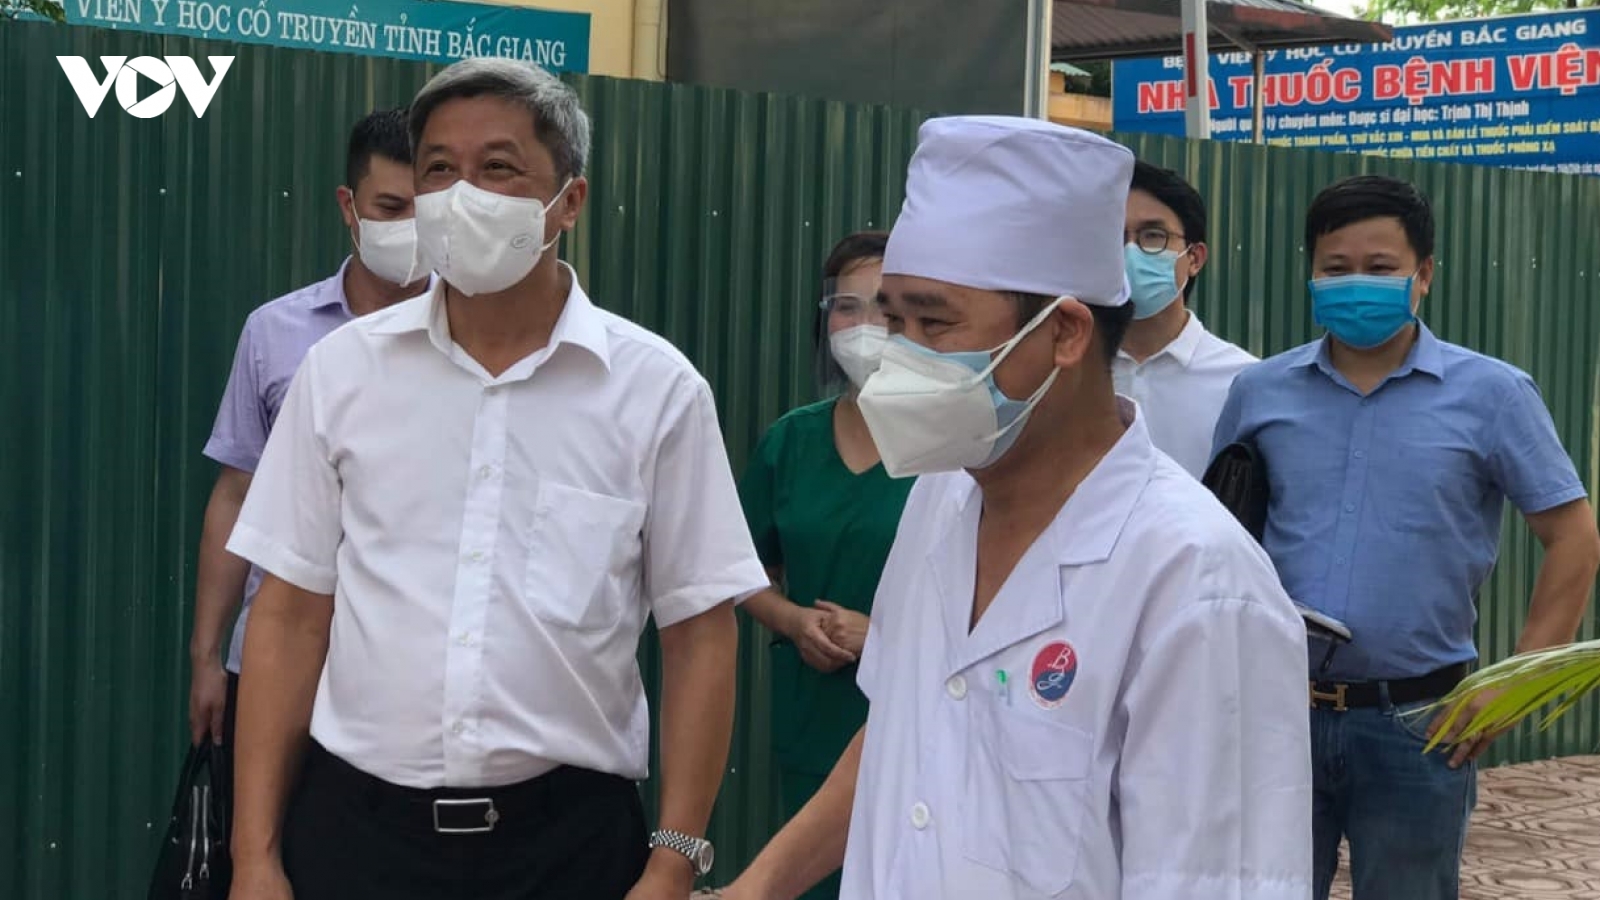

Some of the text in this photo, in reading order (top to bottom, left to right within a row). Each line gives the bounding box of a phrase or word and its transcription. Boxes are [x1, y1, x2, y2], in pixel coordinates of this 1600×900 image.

[178, 1, 231, 38] HỌC
[277, 5, 377, 49] TRUYỀN
[383, 13, 442, 56] TỈNH
[447, 17, 491, 58] BẮC
[496, 36, 567, 67] GIANG
[1515, 18, 1587, 40] GIANG
[1228, 58, 1362, 109] THUỐC
[1373, 56, 1495, 105] BỆNH
[1441, 103, 1472, 123] Trịnh
[1474, 101, 1493, 121] Thị
[1495, 99, 1530, 120] Thịnh
